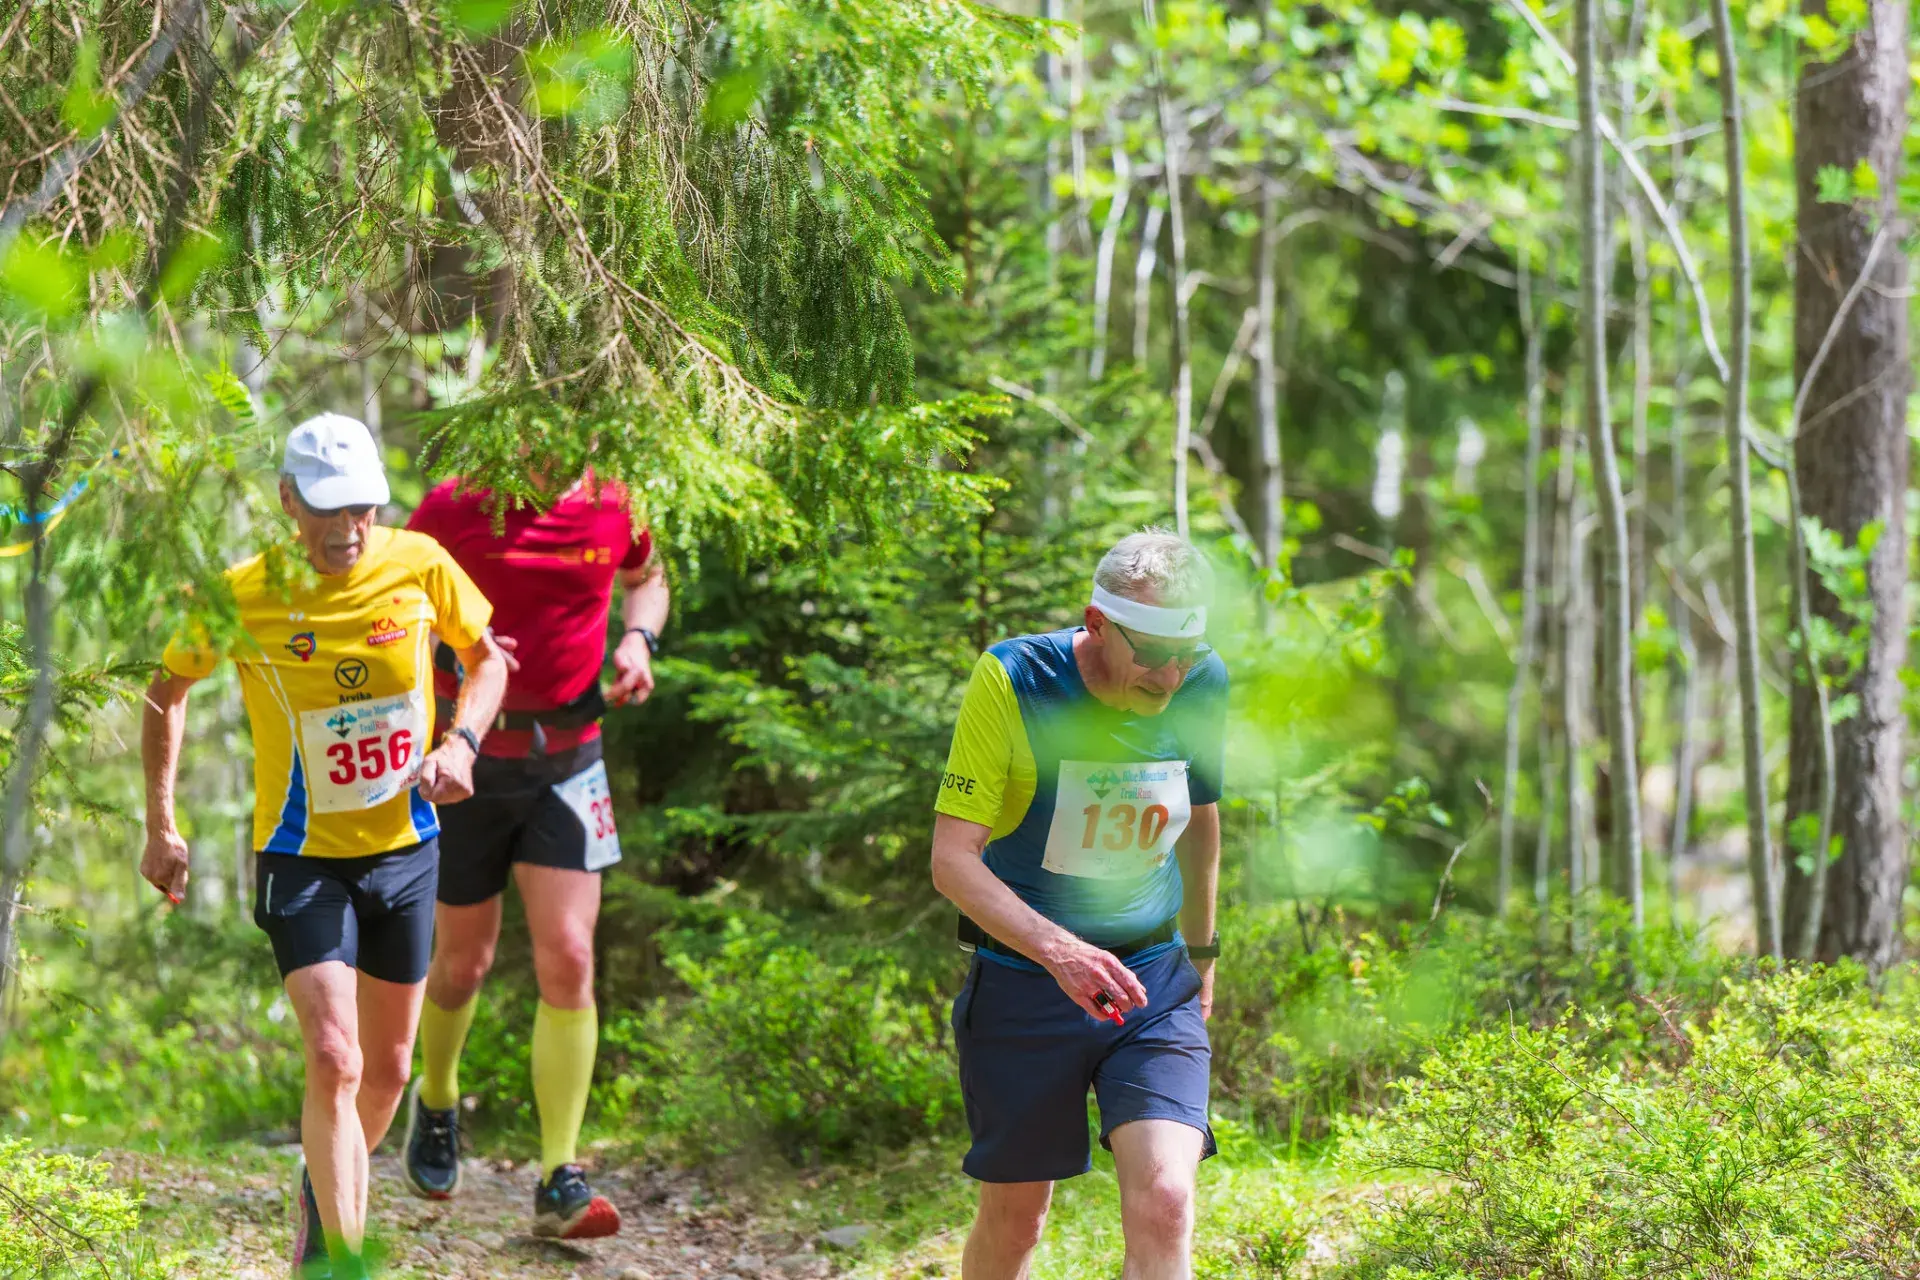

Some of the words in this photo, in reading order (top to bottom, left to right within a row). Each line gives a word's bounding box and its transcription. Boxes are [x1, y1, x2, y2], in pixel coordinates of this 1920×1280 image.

[371, 617, 398, 632] ICA
[339, 692, 373, 704] Arvika
[327, 728, 412, 785] 356
[1081, 804, 1169, 851] 130
